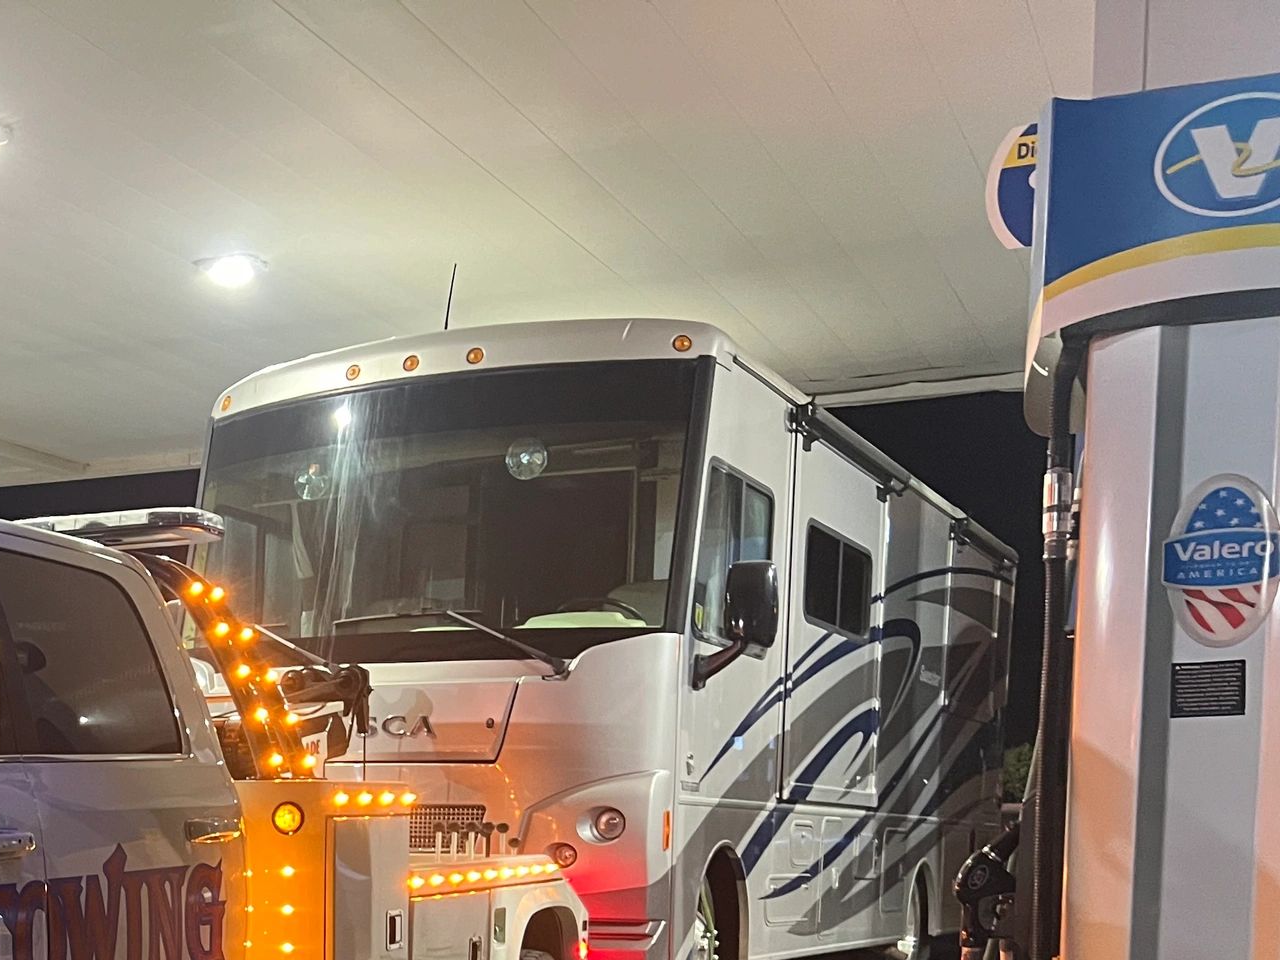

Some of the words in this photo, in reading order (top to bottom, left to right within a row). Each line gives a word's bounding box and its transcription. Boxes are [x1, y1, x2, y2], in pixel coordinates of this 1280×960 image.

[1017, 141, 1038, 160] Di
[1174, 540, 1275, 562] Valero
[1176, 567, 1259, 580] AMERICA
[368, 714, 438, 740] SCA
